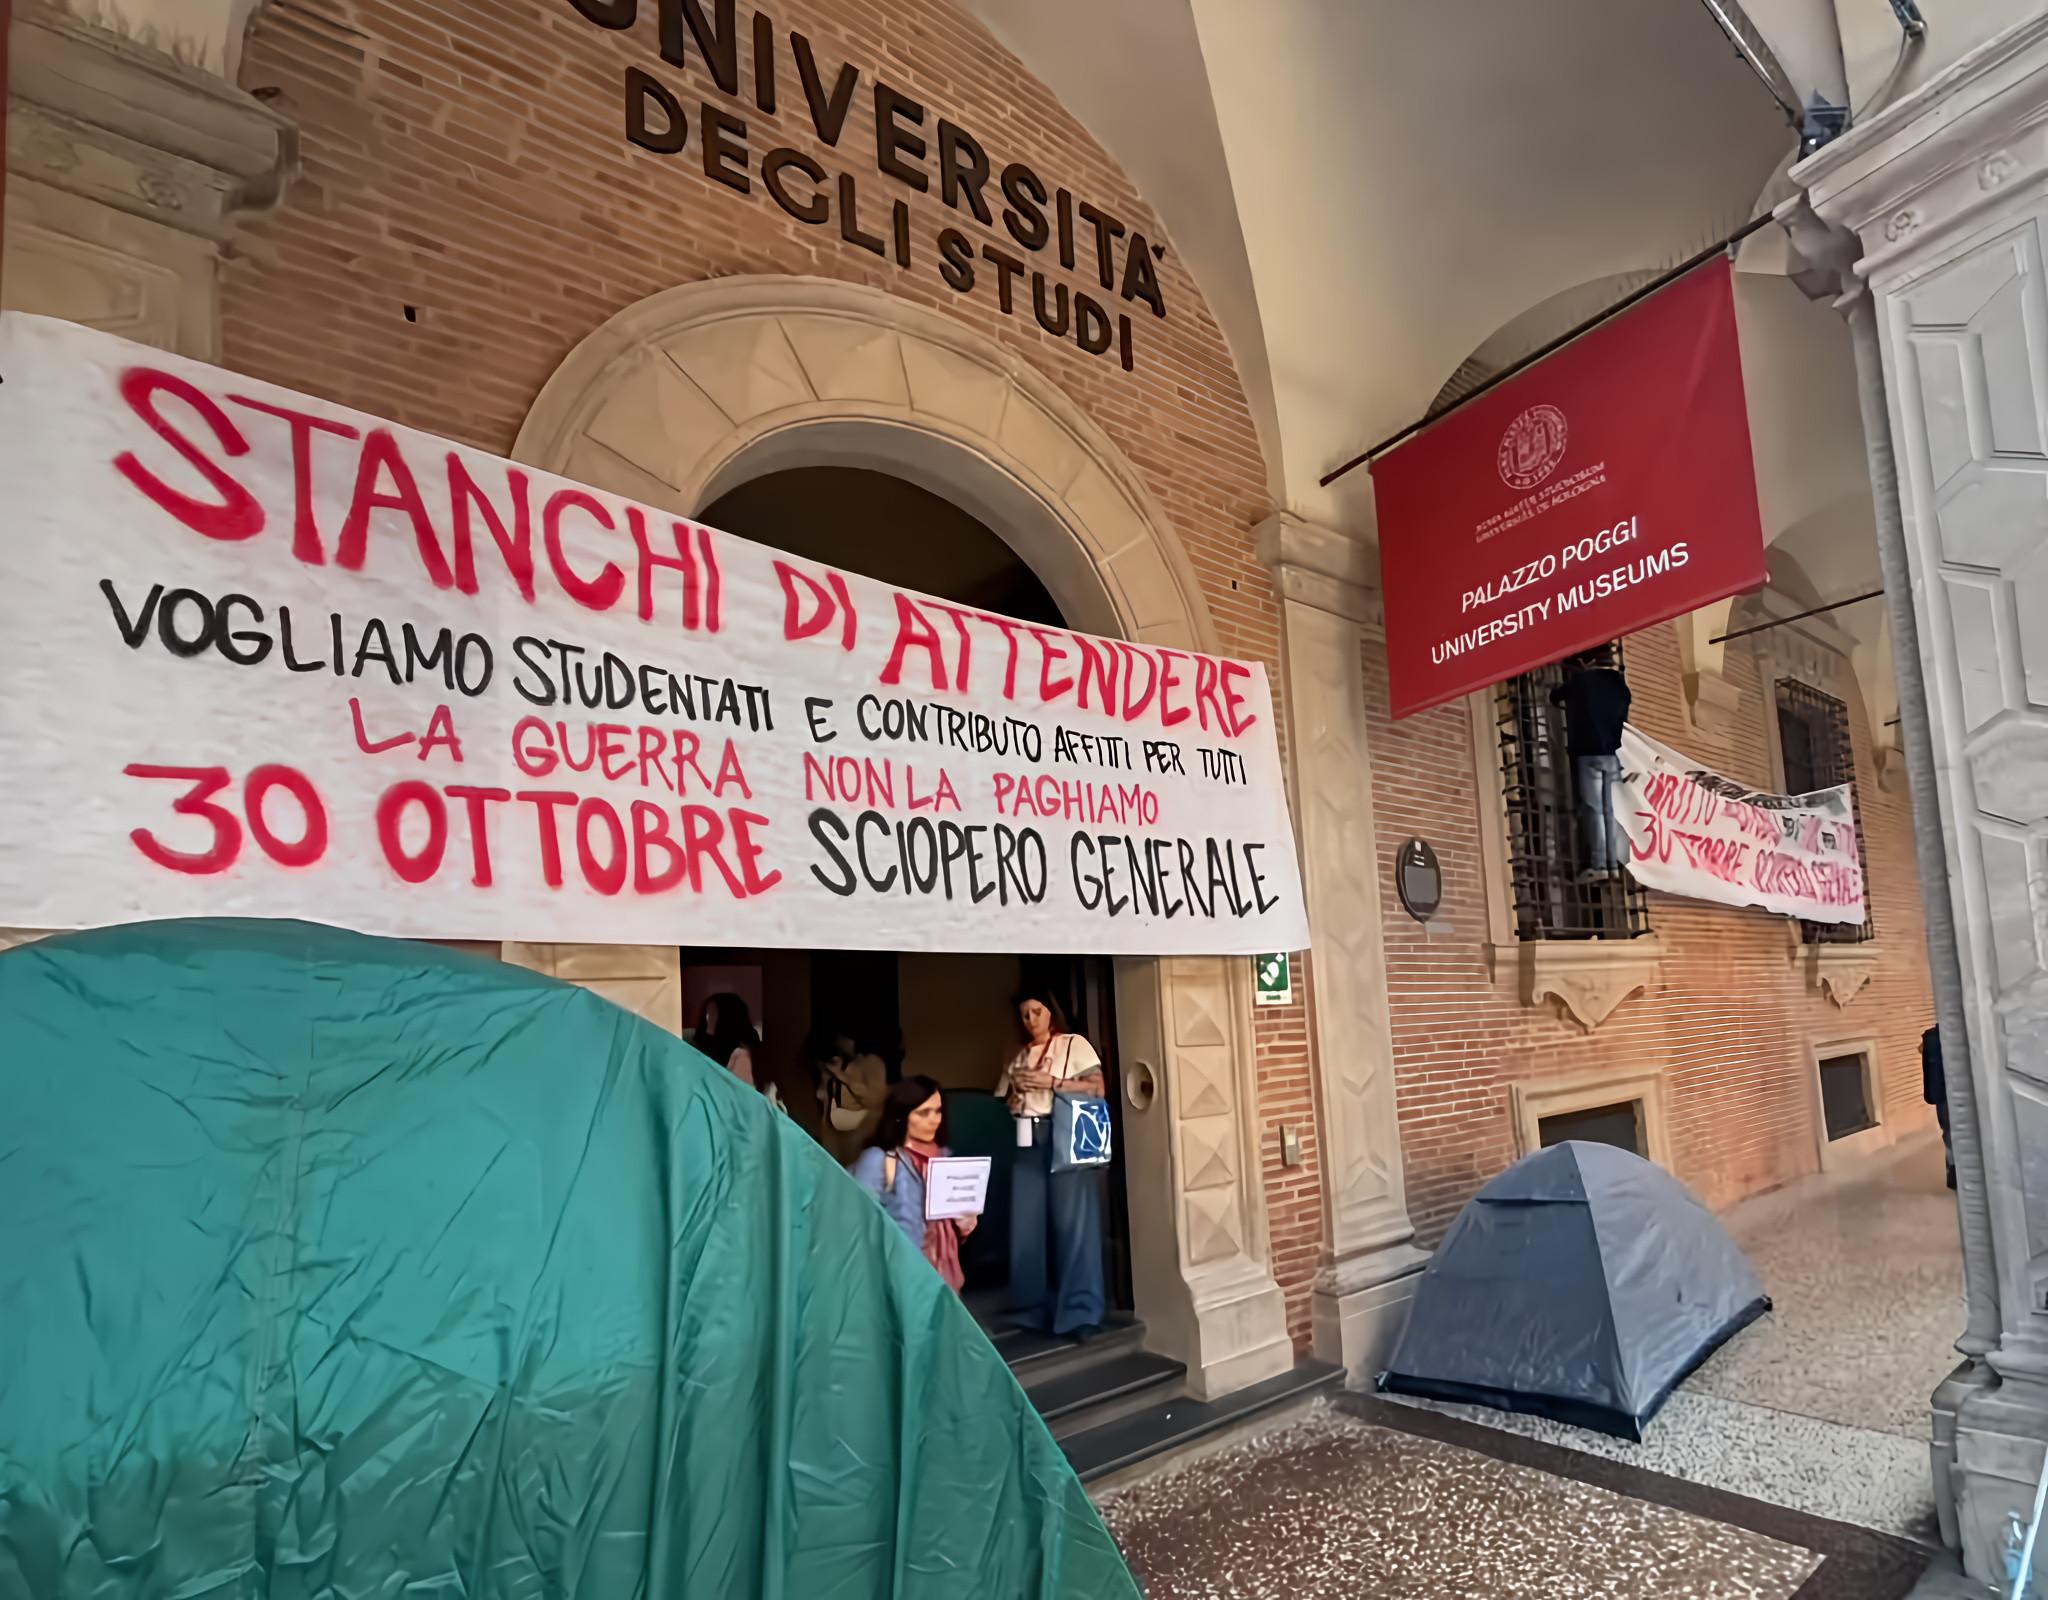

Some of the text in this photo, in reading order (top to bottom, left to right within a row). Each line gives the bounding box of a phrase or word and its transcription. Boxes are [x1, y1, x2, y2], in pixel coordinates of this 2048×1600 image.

[625, 66, 1134, 372] DEGLI STUDI
[113, 367, 1258, 739] STANCHI DI ATTENDERE
[1431, 542, 1689, 664] UNIVERSITY MUSEUMS
[1461, 555, 1556, 613] PALAZZO
[1562, 516, 1637, 569] POGGI
[100, 579, 1247, 785] VOGLIAMO STUDENTATI E CONTRIBUTO AFFITTI PER TUTTI
[349, 697, 1159, 826] LA GUERRA NON LA PAGHIAMO
[123, 763, 1280, 919] 30 OTTOBRE SCIOPERO GENERALE
